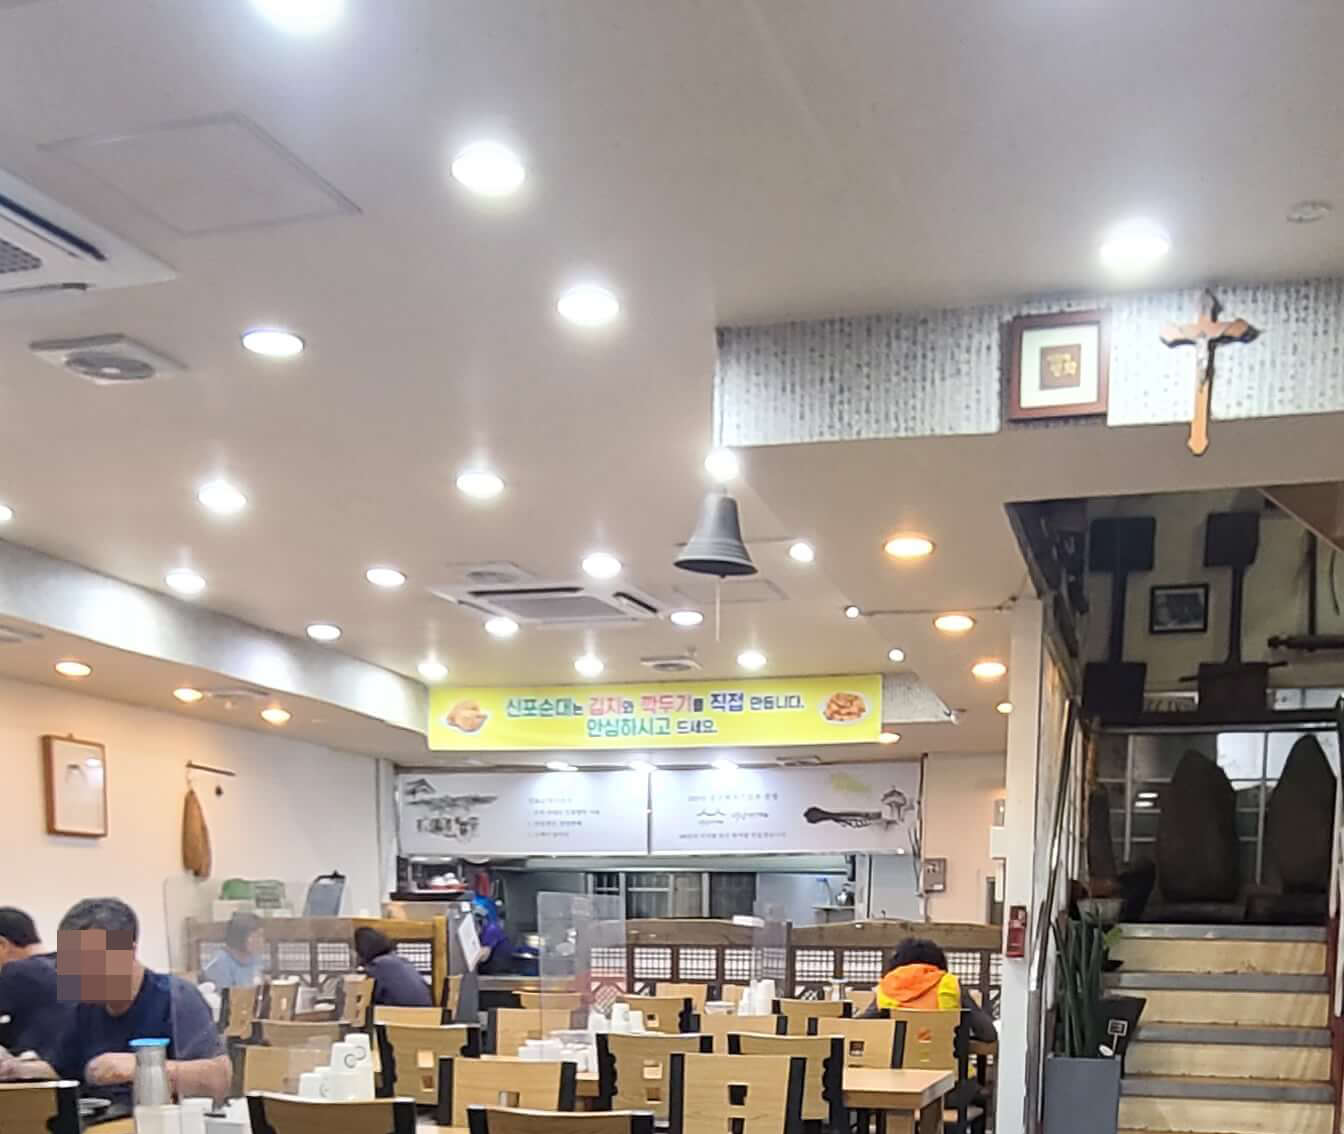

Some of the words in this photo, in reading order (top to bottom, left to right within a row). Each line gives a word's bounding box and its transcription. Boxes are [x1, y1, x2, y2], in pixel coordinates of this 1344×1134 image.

[508, 697, 583, 718] 신포순대는
[590, 696, 633, 716] 김치와
[640, 694, 704, 713] 깍두기를
[710, 692, 744, 712] 직접
[587, 717, 671, 737] 안심하시고
